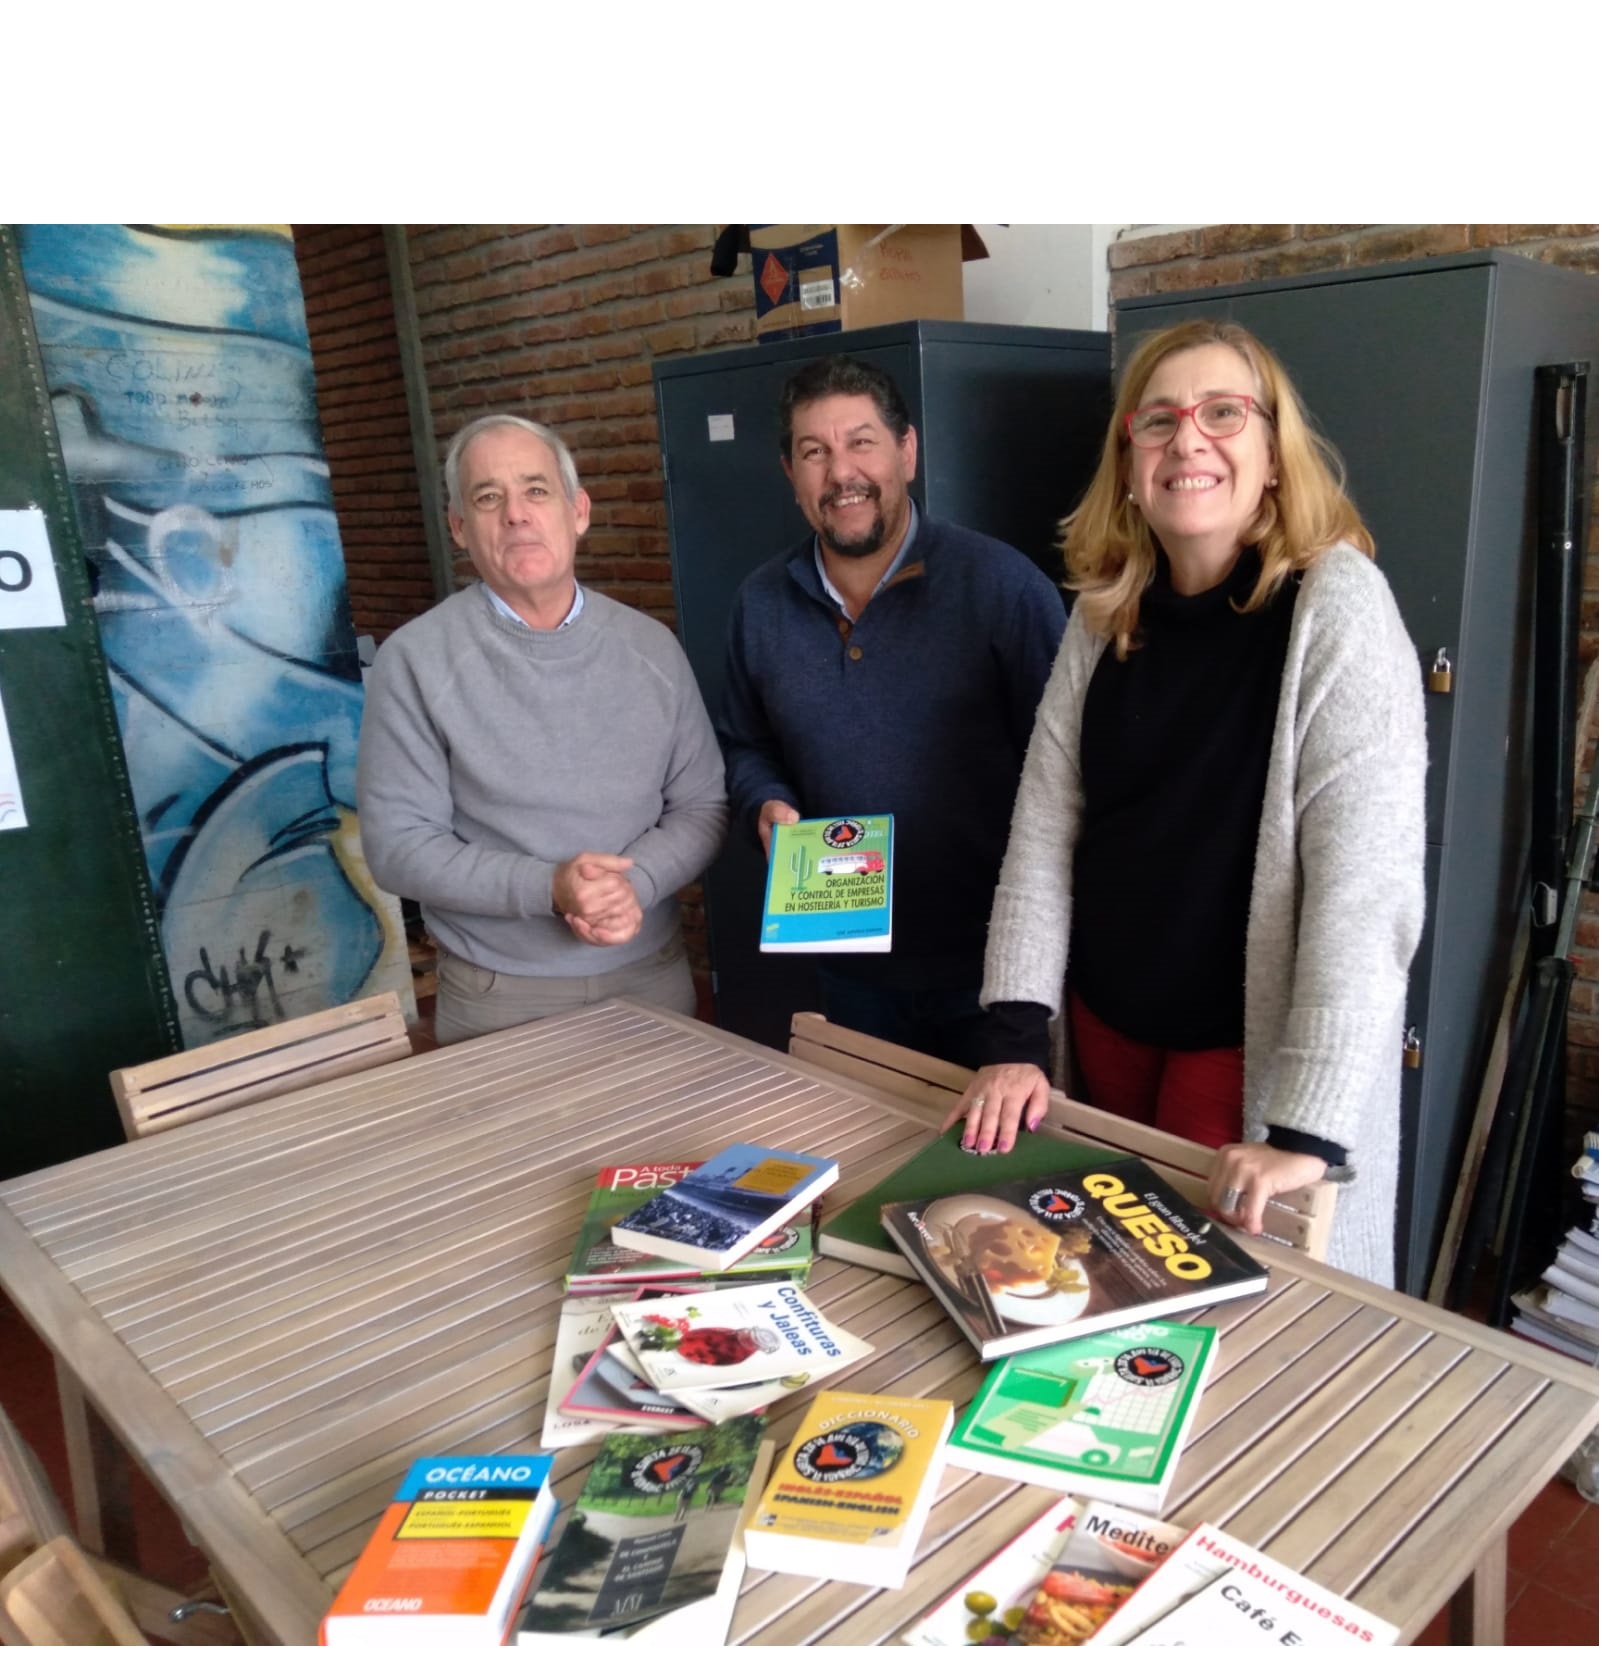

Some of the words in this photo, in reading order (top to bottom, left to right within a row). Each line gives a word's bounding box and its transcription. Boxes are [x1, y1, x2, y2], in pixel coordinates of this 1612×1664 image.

[791, 890, 796, 900] Y
[797, 889, 833, 900] CONTROL
[835, 888, 844, 898] DE
[847, 884, 885, 898] EMPRESAS
[784, 902, 796, 912] EN
[843, 899, 849, 908] Y
[851, 896, 885, 908] TURISMO
[653, 1164, 682, 1172] toda
[610, 1166, 694, 1192] Past
[1144, 1192, 1159, 1200] El
[1148, 1200, 1172, 1217] gran
[1082, 1173, 1212, 1280] QUESO
[1168, 1215, 1190, 1233] libro
[1187, 1232, 1207, 1245] del
[757, 1300, 776, 1309] y
[770, 1313, 813, 1356] Jaleas
[777, 1287, 841, 1357] Confituras
[818, 1410, 921, 1440] DICCIONARIO
[425, 1463, 532, 1483] OCÉANO
[423, 1490, 487, 1500] POCKET
[1196, 1536, 1375, 1643] Hamburguesas
[1220, 1584, 1276, 1632] Café
[1278, 1630, 1306, 1647] E
